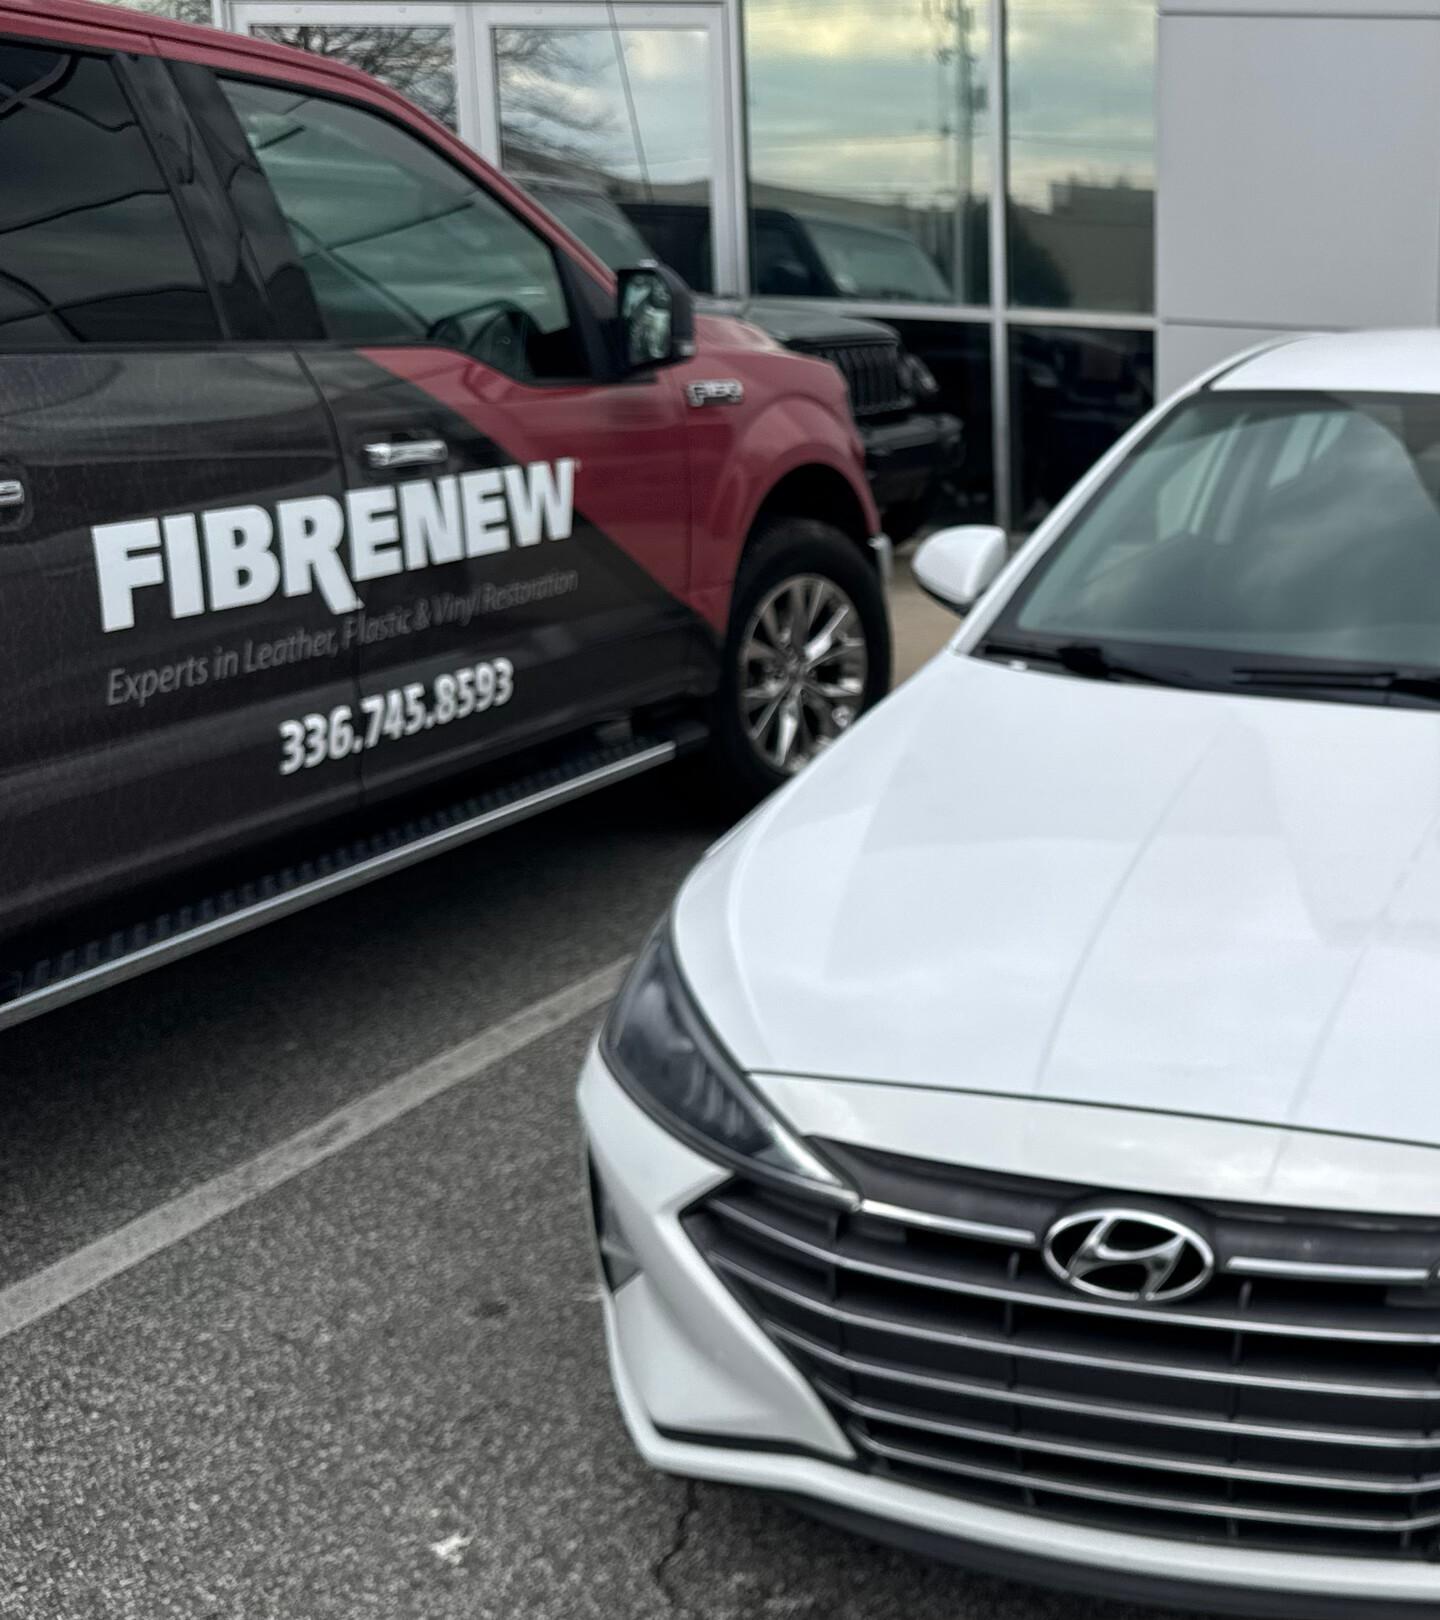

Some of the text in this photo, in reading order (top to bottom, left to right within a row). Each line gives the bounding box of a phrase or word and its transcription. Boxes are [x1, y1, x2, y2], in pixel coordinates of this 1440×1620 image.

[91, 457, 577, 634] FIBRENEW
[107, 569, 578, 707] Experts in Leather, Plastic & Vinyl Restoration
[278, 656, 515, 776] 336.745.8593
